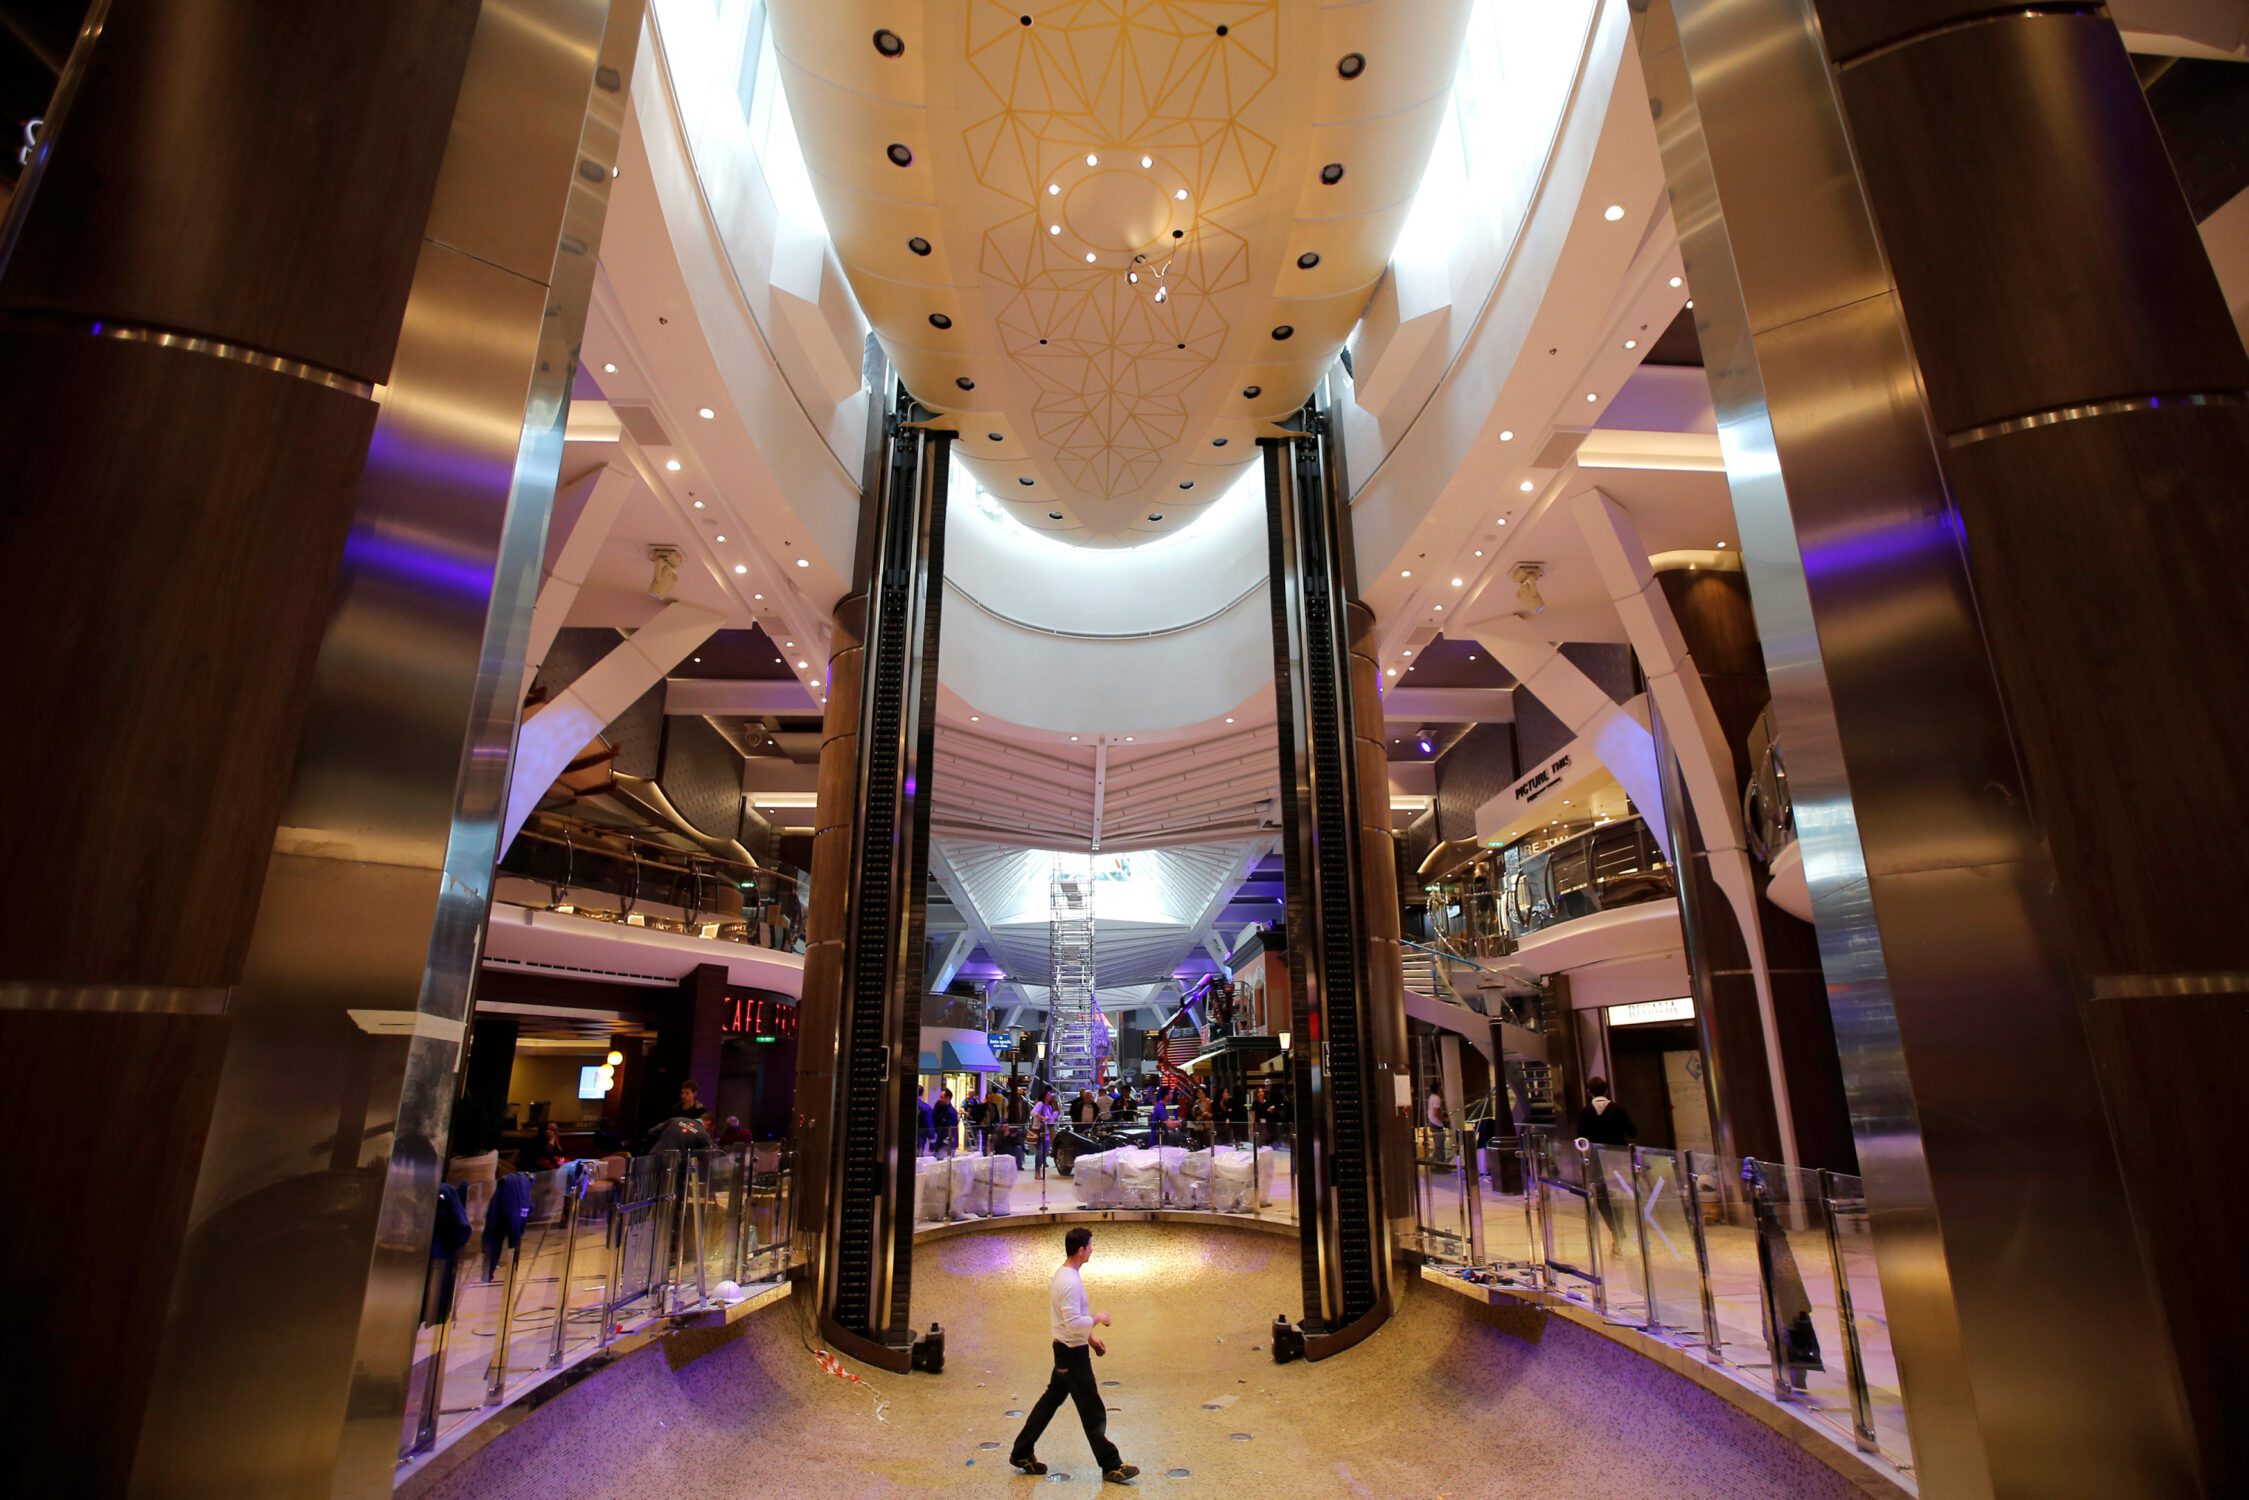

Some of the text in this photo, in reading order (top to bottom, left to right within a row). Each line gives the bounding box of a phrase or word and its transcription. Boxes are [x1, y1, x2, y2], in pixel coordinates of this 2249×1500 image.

[1515, 769, 1550, 800] PICTURE
[1552, 755, 1570, 774] THIS
[722, 996, 764, 1033] CAFE
